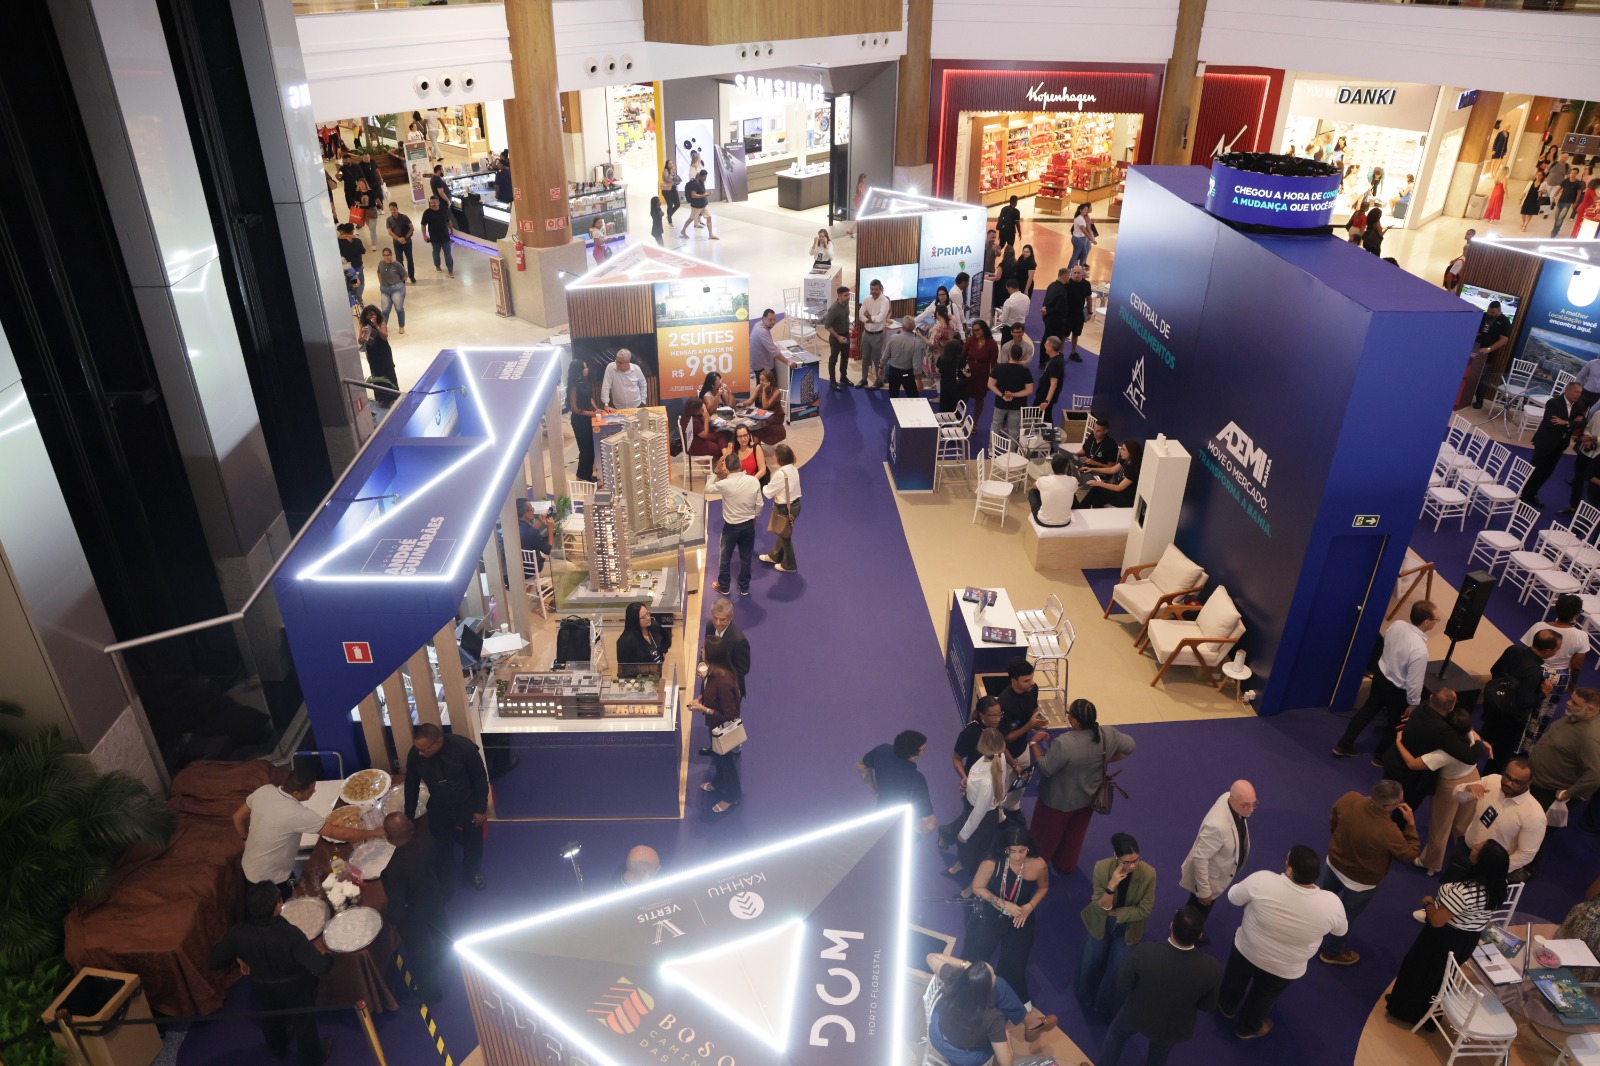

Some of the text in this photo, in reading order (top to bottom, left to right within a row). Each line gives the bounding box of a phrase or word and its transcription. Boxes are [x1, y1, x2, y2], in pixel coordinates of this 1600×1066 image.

[735, 74, 824, 104] SAMSUNG
[1026, 81, 1096, 111] Kopenhagen
[1338, 88, 1396, 105] DANKI
[1232, 196, 1239, 204] A
[1240, 198, 1287, 212] MUDANÇA
[1290, 203, 1309, 211] QUE
[1311, 201, 1328, 211] VOCÊ
[1234, 185, 1273, 199] CHEGOU
[1274, 191, 1281, 199] A
[1283, 191, 1310, 200] HORA
[1311, 192, 1322, 201] DE
[937, 245, 972, 257] PRIMA
[1129, 292, 1171, 340] CENTRAL DE
[1548, 318, 1577, 330] encontra
[669, 328, 735, 348] 2 SUÍTES
[1118, 304, 1176, 370] FINANCIAMENTOS
[671, 349, 698, 357] MENSAIS
[672, 353, 733, 378] R$ 980
[1126, 381, 1146, 410] ACT
[1215, 420, 1268, 484] ADEMI
[1207, 440, 1268, 513] MOVE O MERCADO,
[1261, 459, 1273, 488] BAHIA
[1199, 449, 1272, 538] TRANSFORMA A BAHIA.
[384, 538, 418, 576] ANDRÉ
[401, 516, 445, 576] GUIMARÃES
[707, 872, 767, 899] KAHHU
[637, 904, 682, 923] VERTIS
[809, 928, 865, 1047] DOM
[867, 948, 882, 1036] HORTO FLORESTAL
[640, 1039, 669, 1063] DAS
